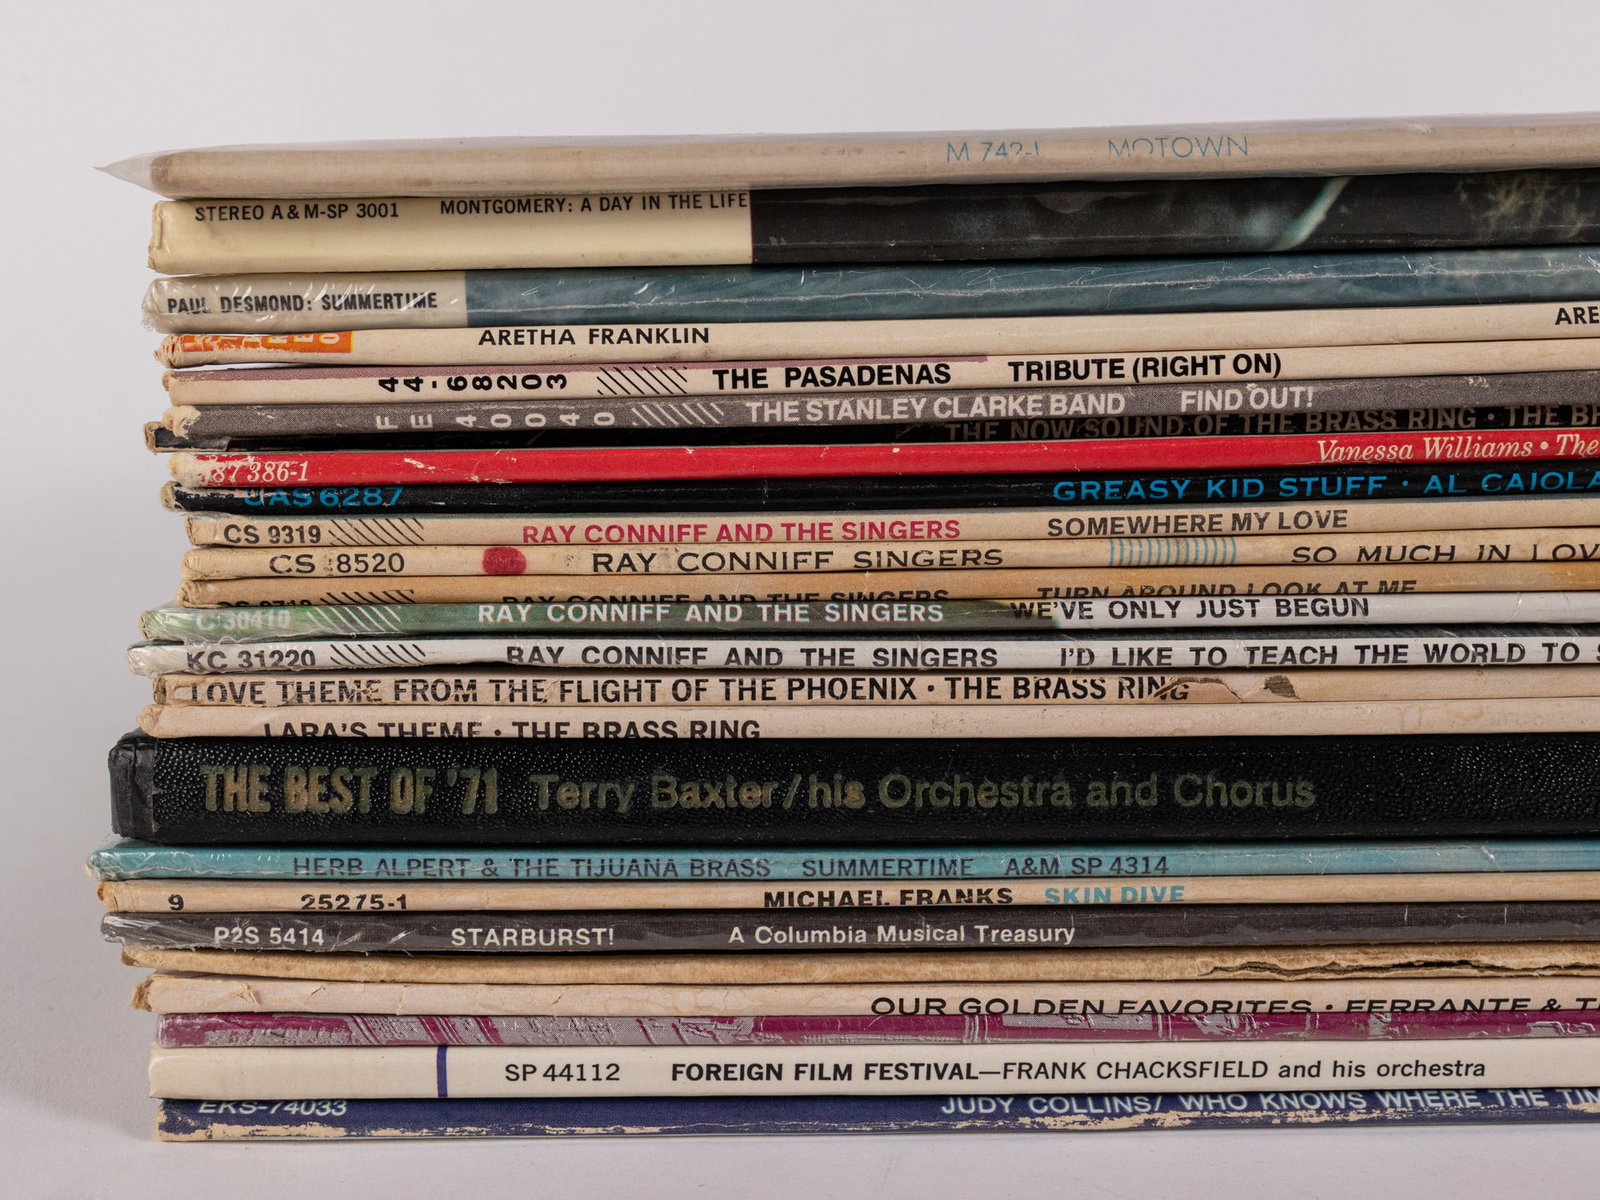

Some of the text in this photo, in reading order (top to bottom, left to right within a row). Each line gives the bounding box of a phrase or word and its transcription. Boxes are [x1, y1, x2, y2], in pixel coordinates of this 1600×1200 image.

[946, 136, 1249, 162] M MOTOWN
[195, 192, 748, 223] STEREO 3001 MONTGOMERY: A DAY IN THE LIFE
[167, 291, 438, 314] PAUL DESMOND: SUMMERTIME
[478, 327, 710, 346] ARETHA FRANKLIN
[378, 352, 1282, 393] 44-68203 THE PASADENAS TRIBUTE (RIGHT ON)
[745, 385, 1314, 423] THE STANLEY CLARKE BAND FIND OUT!
[945, 405, 1560, 441] THE NOW SOUND OF THE BRASS RING THE
[246, 434, 1599, 482] 386-1 Vanessa Williams The
[319, 485, 405, 507] 6287
[1053, 479, 1192, 500] GREASY
[1207, 477, 1265, 499] KID
[1278, 475, 1388, 497] STUFF
[1423, 475, 1467, 495] AL
[223, 509, 1348, 544] CS 9319 RAY CONNIFF AND THE SINGERS SOMEWHERE MY LOVE
[269, 543, 1511, 574] CS 8520 RAY CONNIFF SINGERS SO MUCH IN
[478, 604, 533, 624] RAY
[547, 602, 672, 623] CONNIFF
[684, 602, 743, 623] AND
[756, 602, 810, 623] THE
[824, 602, 945, 622] SINGERS
[1108, 599, 1182, 619] ONLY
[1196, 598, 1260, 619] JUST
[1275, 597, 1370, 617] BEGUN
[186, 650, 228, 671] KC
[237, 649, 316, 668] 31220
[506, 646, 565, 665] RAY
[581, 645, 709, 666] CONNIFF
[724, 647, 784, 666] AND
[800, 647, 855, 666] THE
[872, 647, 998, 667] SINGERS
[1111, 646, 1173, 666] LIKE
[1189, 646, 1227, 666] TO
[1246, 645, 1338, 665] TEACH
[1354, 644, 1409, 664] THE
[1424, 642, 1526, 662] WORLD
[1542, 641, 1580, 662] TO
[276, 679, 382, 703] THEME
[393, 678, 478, 703] FROM
[489, 679, 548, 703] THE
[560, 678, 662, 703] FLIGHT
[671, 678, 710, 702] OF
[719, 677, 777, 701] THE
[787, 676, 916, 701] PHOENIX
[945, 676, 1002, 700] THE
[1013, 676, 1106, 700] BRASS
[1118, 676, 1189, 700] RING
[511, 721, 571, 738] THE
[582, 720, 678, 738] BRASS
[690, 719, 761, 738] RING
[200, 765, 272, 813] THE
[282, 765, 379, 815] BEST
[389, 766, 436, 815] OF
[528, 773, 637, 813] Terry
[877, 773, 1073, 809] Orchestra
[1086, 773, 1159, 808] and
[1173, 773, 1317, 809] Chorus
[293, 855, 1169, 877] HERB ALPERT & THE TIJUANA BRASS SUMMERTIME A&M SP 4314
[167, 894, 184, 911] 9
[300, 893, 408, 911] 25275-1
[899, 887, 1014, 906] FRANKS
[1044, 887, 1112, 904] SKIN
[1120, 885, 1185, 903] DIVE
[214, 924, 1076, 947] P2S 5414 STARBURST! A Columbia Musical Treasury
[870, 997, 947, 1015] OUR
[959, 998, 1105, 1015] GOLDEN
[1118, 998, 1315, 1014] FAVORITES
[504, 1058, 1486, 1082] SP 44112 FOREIGN FILM CHACKSFIELD and his orchestra
[941, 1089, 1549, 1114] JUDY WHO KNOWS WHERE THE
